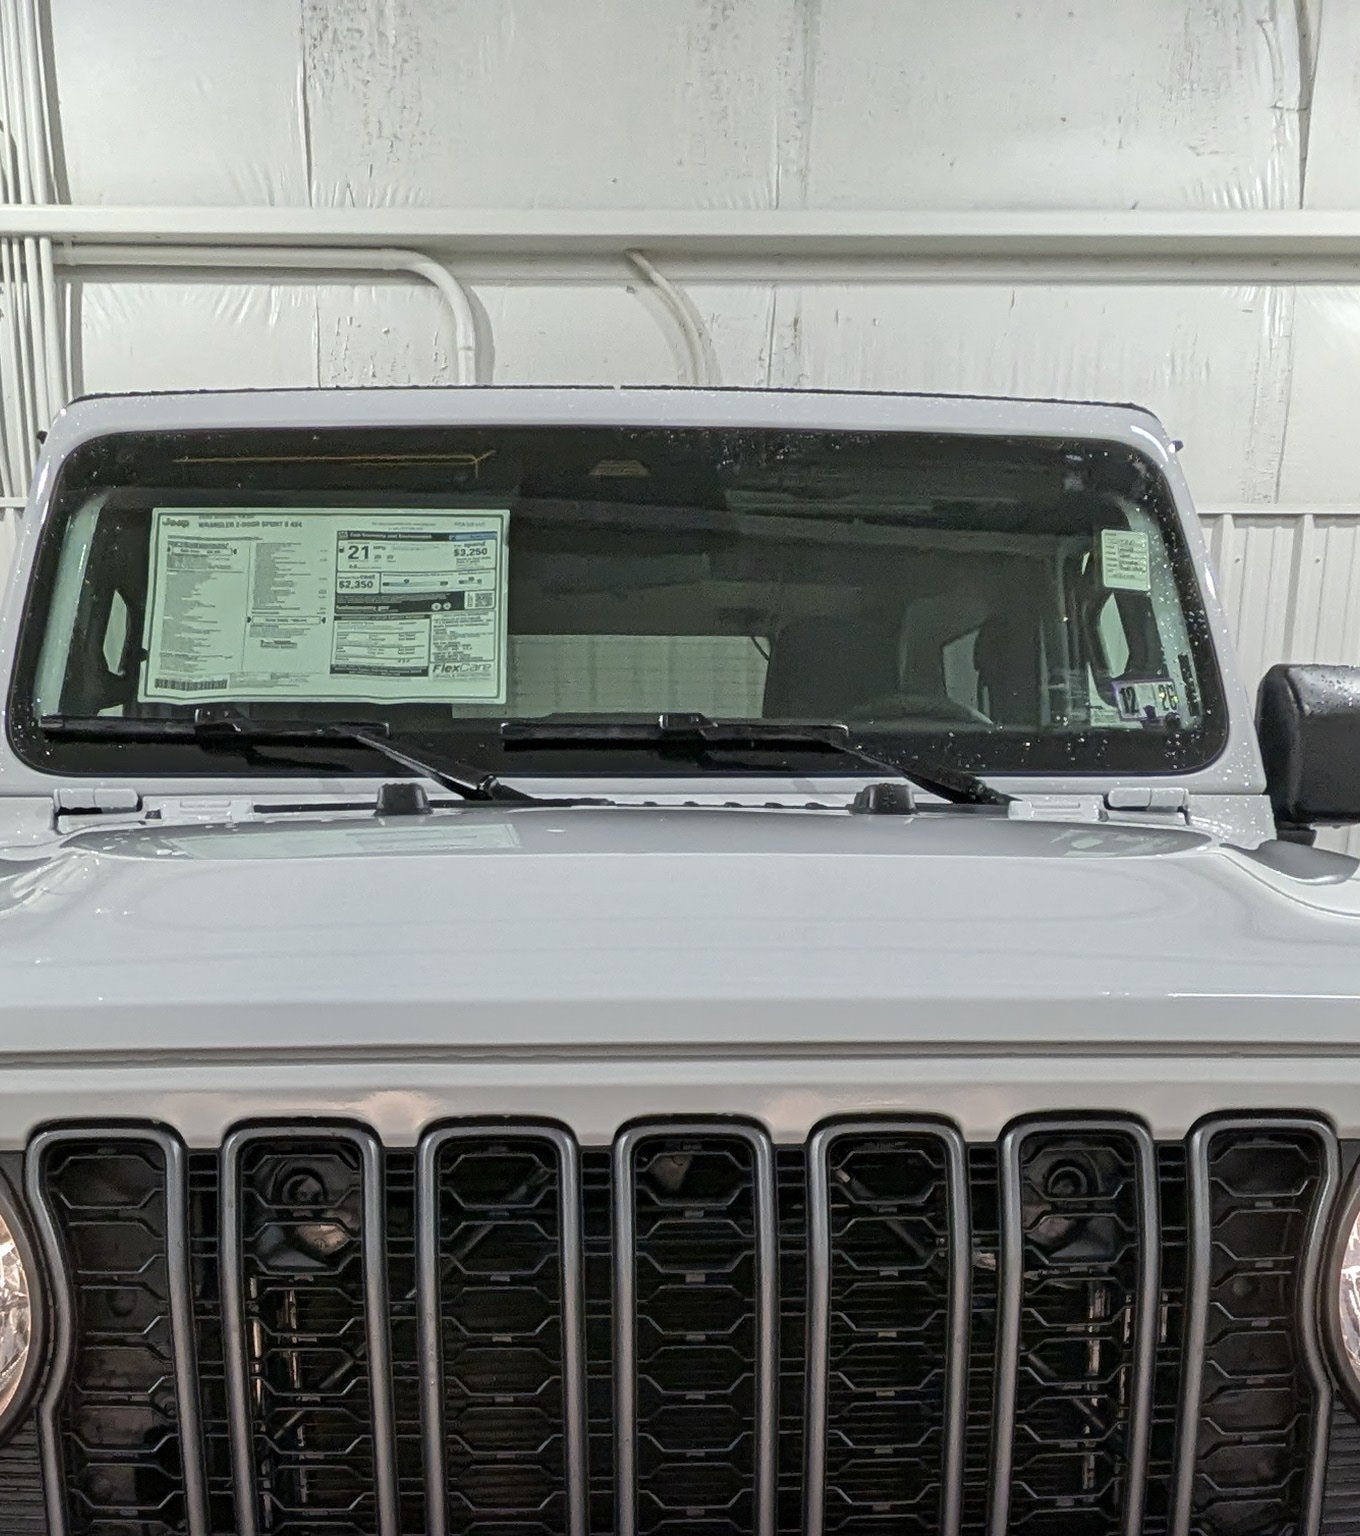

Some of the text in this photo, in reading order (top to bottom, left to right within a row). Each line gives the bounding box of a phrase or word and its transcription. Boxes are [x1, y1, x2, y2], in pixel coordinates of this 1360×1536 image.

[162, 517, 189, 528] Jeep
[347, 545, 369, 560] 21
[453, 547, 488, 557] $3,250
[339, 580, 374, 590] $2,350
[432, 662, 493, 674] FlexCare
